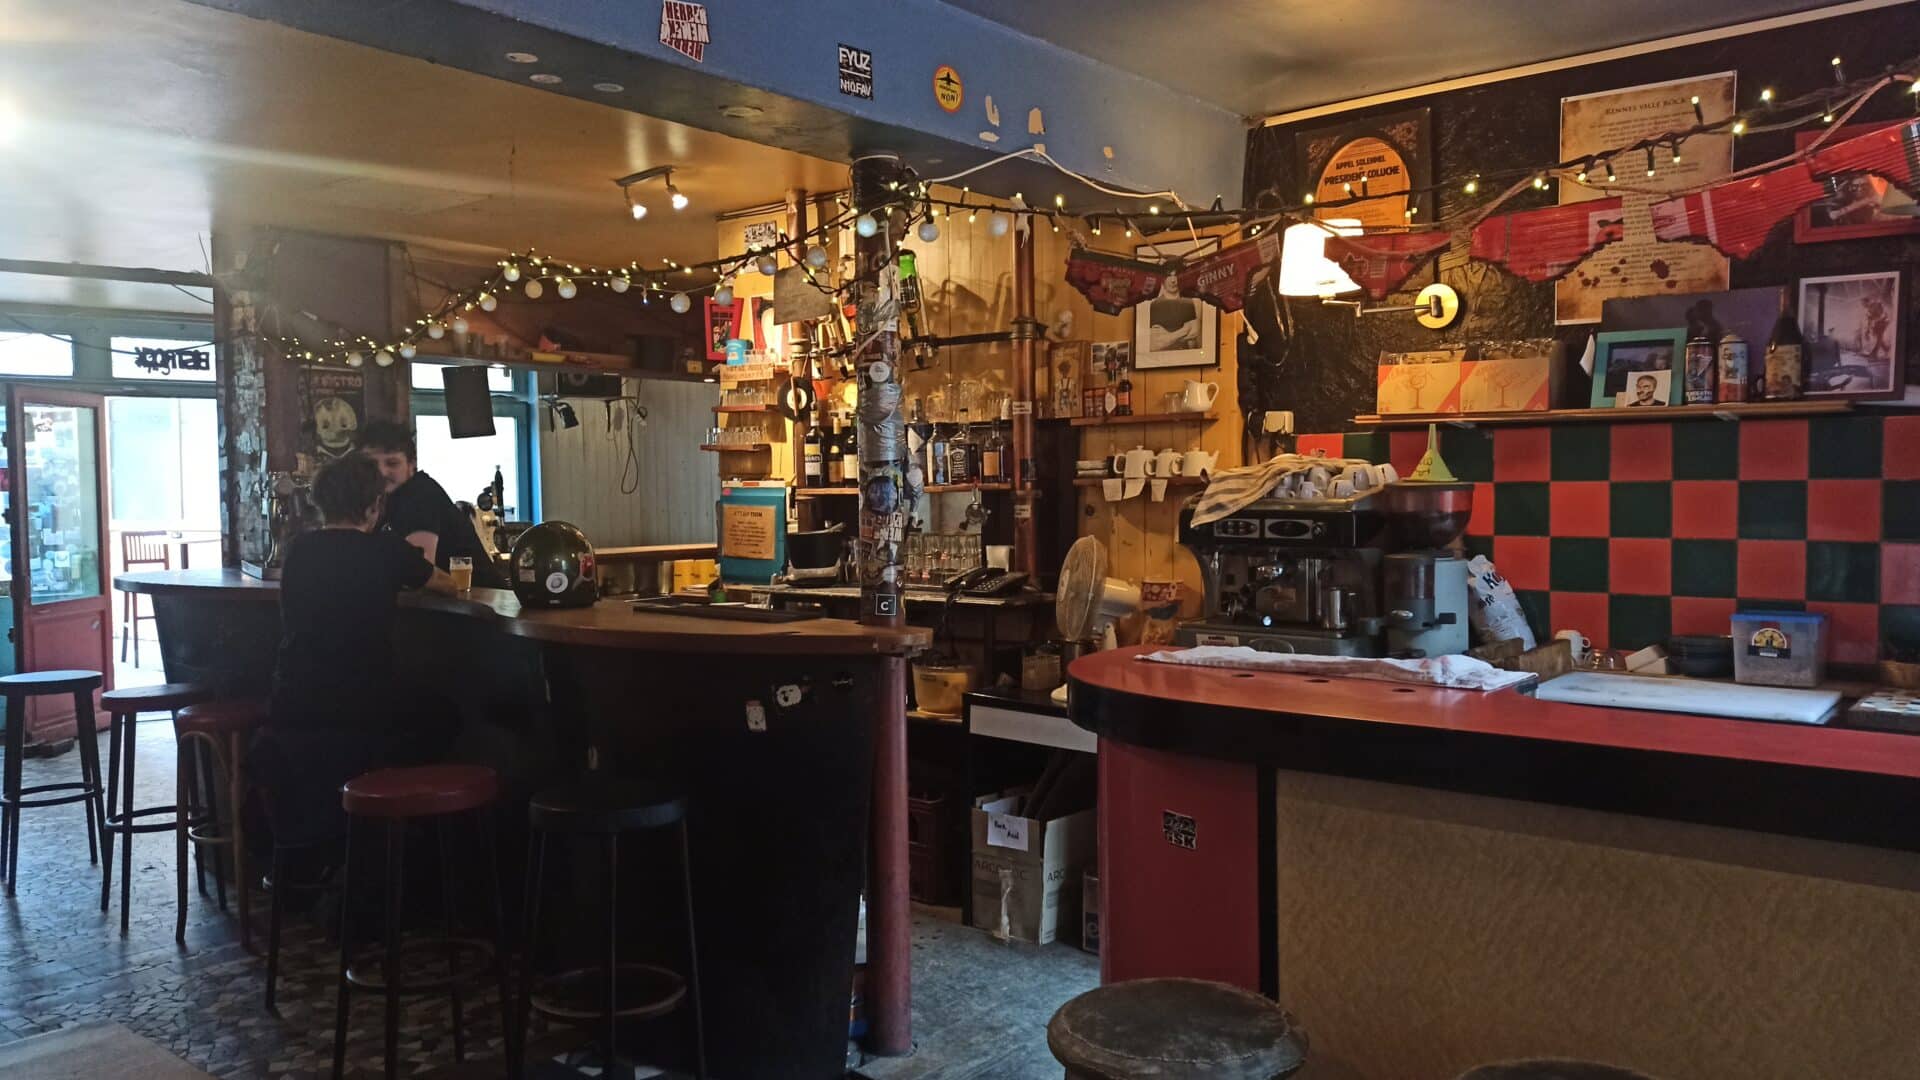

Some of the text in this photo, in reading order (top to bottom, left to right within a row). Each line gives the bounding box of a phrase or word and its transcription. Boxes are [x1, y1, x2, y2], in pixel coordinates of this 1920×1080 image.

[839, 47, 871, 71] FYUZ
[1336, 160, 1355, 170] APPEL
[1367, 165, 1401, 178] COLUCHE
